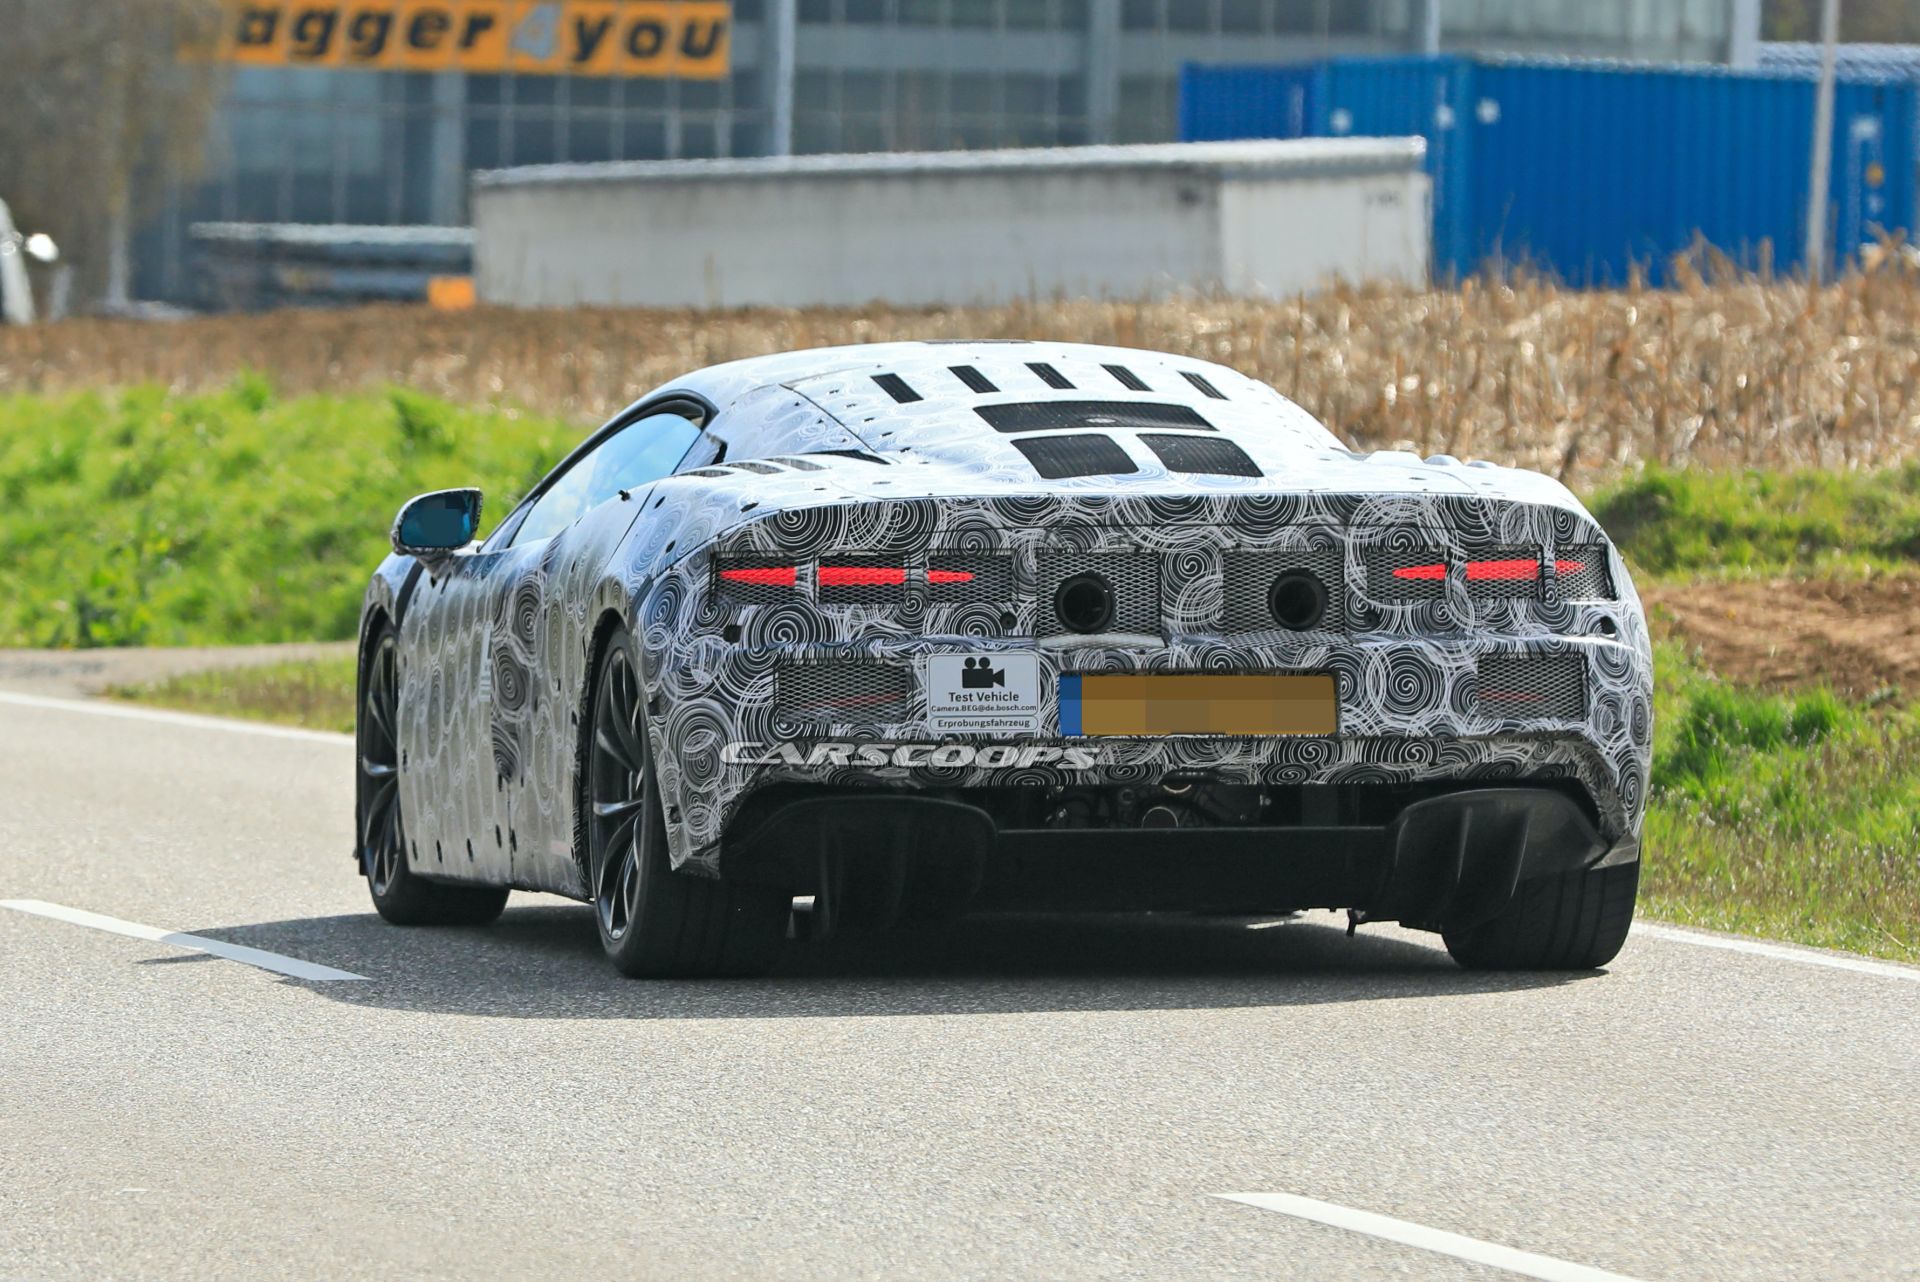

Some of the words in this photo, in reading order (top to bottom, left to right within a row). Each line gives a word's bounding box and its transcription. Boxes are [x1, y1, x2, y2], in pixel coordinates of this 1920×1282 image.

[949, 691, 973, 702] Test
[977, 691, 1019, 702] Vehicle
[938, 719, 1030, 728] Erprobungsfahrzeug
